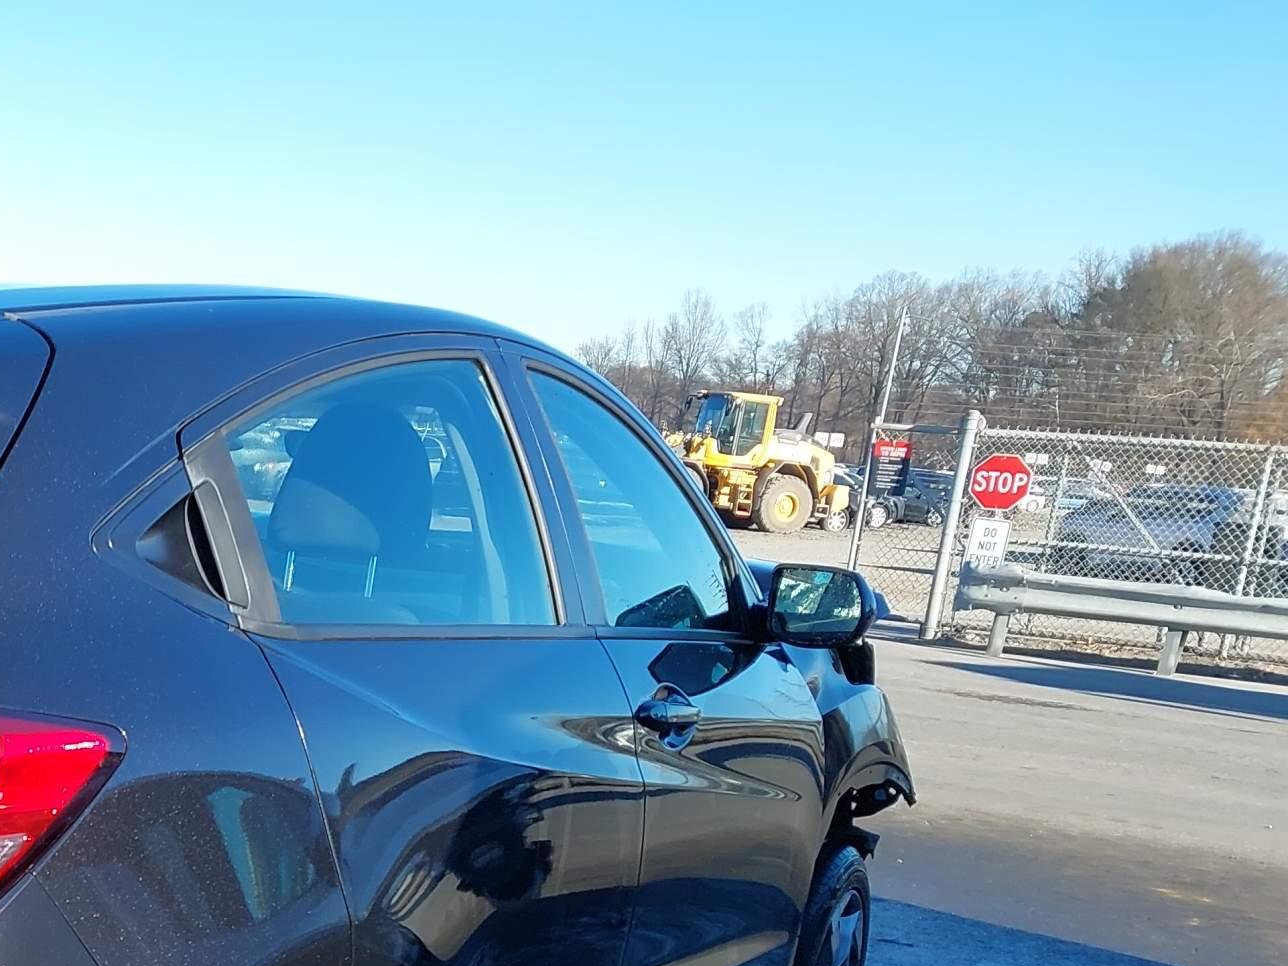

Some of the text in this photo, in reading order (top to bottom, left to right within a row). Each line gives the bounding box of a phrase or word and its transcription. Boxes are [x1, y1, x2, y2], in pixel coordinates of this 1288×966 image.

[973, 470, 1028, 494] STOP
[983, 527, 998, 538] DO
[977, 541, 998, 551] NOT
